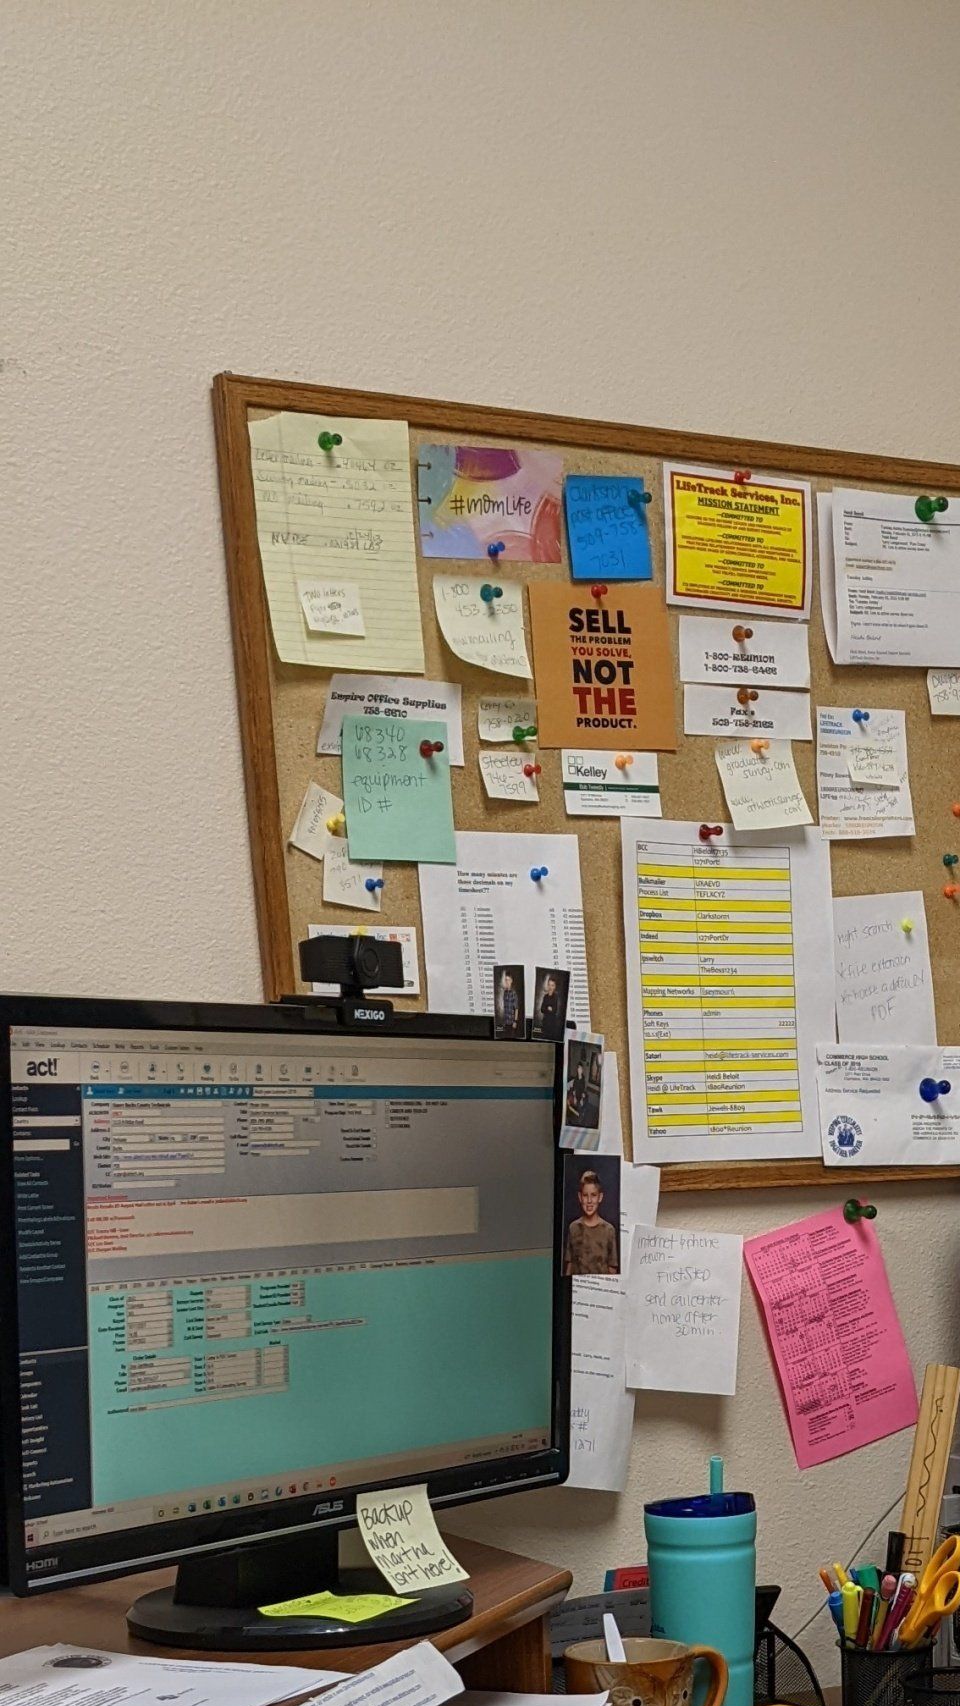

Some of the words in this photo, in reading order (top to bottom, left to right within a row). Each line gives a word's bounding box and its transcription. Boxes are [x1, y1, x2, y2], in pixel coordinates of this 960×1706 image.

[676, 479, 728, 498] LifeTrack
[730, 488, 779, 505] Services,
[780, 494, 800, 506] Inc.
[697, 497, 734, 509] MISSION
[734, 502, 779, 516] STATEMENT
[568, 608, 632, 635] SELL
[570, 635, 587, 644] THE
[589, 635, 631, 646] PROBLEM
[571, 646, 595, 657] YOU
[596, 647, 632, 659] SOLVE,
[572, 659, 635, 685] NOT
[330, 691, 365, 704] Empire
[402, 697, 447, 710] Supplies
[572, 687, 637, 716] THE
[576, 717, 637, 729] PRODUCT.
[576, 765, 608, 780] Kelley
[351, 771, 430, 793] equipment
[357, 797, 372, 813] ID
[377, 797, 393, 813] #
[638, 889, 658, 897] Process
[659, 889, 669, 897] List
[639, 911, 662, 919] Dropbox
[354, 1009, 385, 1021] NEXIGO
[643, 1009, 663, 1017] Phones
[656, 1020, 669, 1029] Keys
[26, 1058, 58, 1077] act!
[646, 1074, 663, 1082] Skype
[312, 1500, 343, 1516] ASUS
[26, 1557, 59, 1572] HDMI
